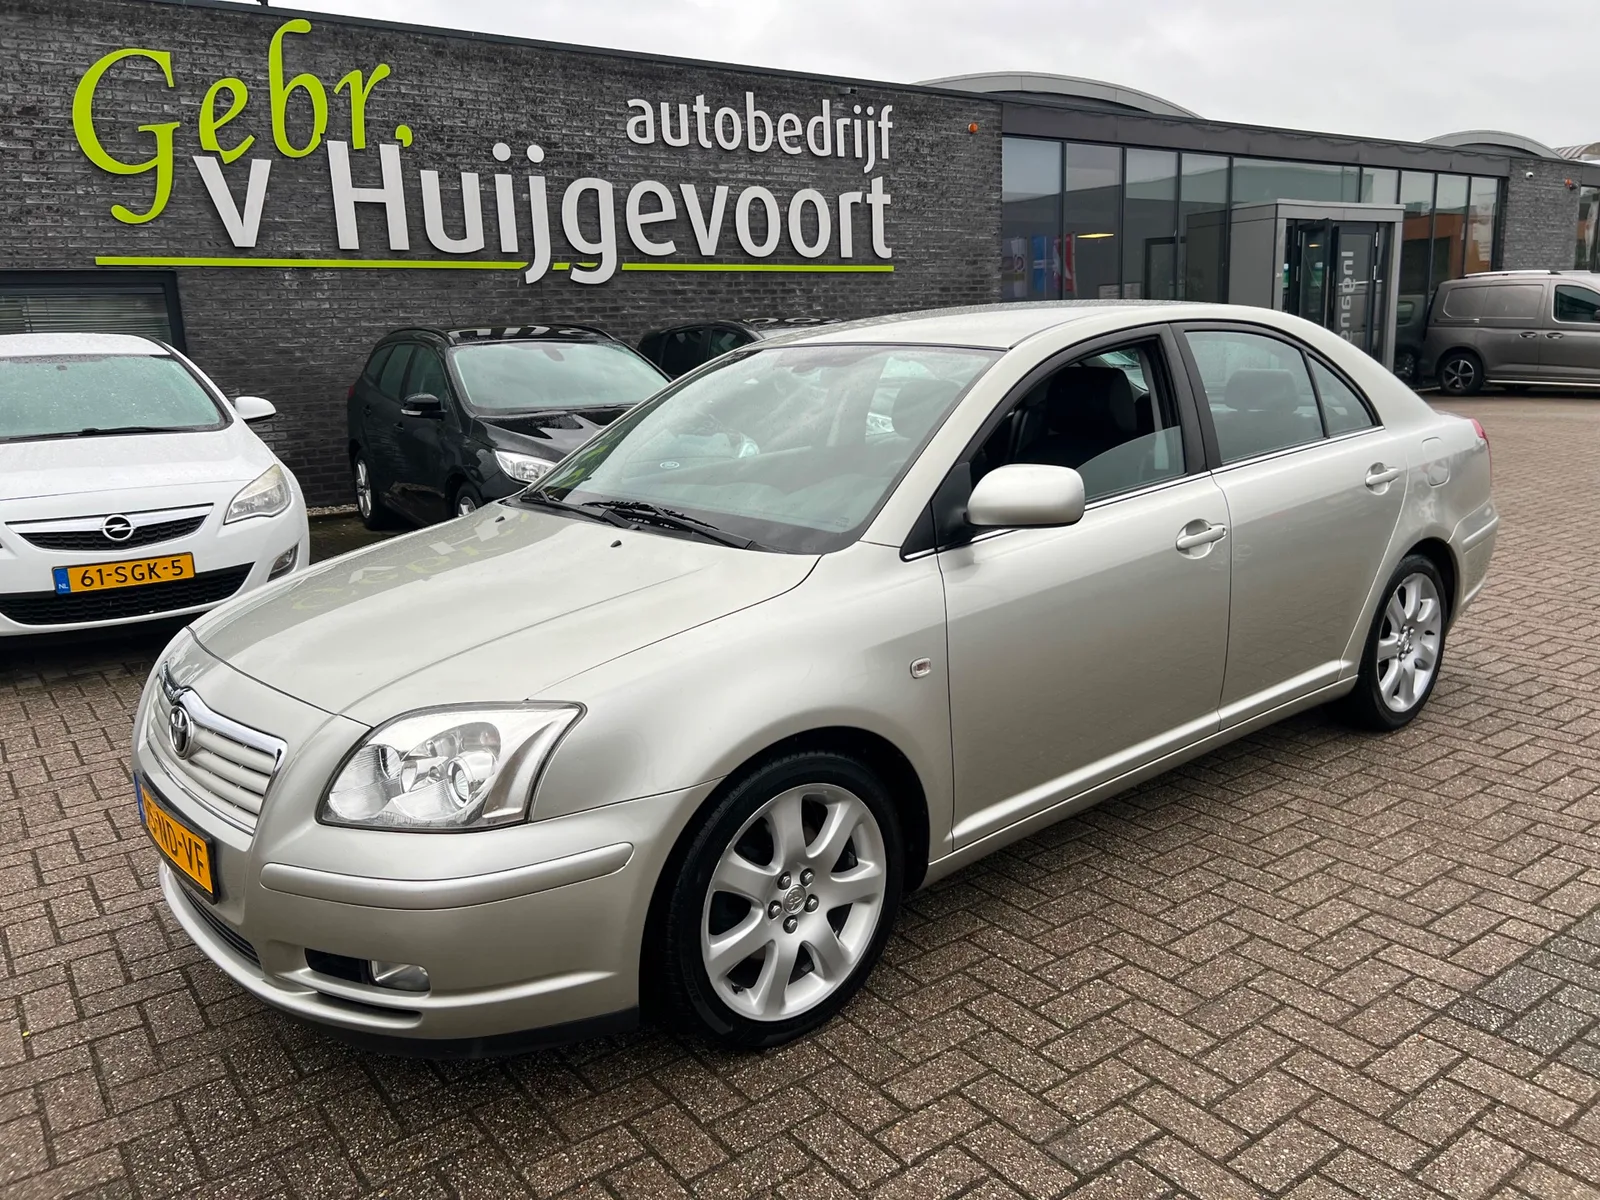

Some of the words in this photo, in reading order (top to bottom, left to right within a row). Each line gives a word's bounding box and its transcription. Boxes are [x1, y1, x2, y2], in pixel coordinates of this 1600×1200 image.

[72, 19, 413, 224] Gebr.
[626, 91, 893, 174] autobedrijf
[193, 155, 272, 248] v
[327, 140, 893, 285] Huijgevoort
[80, 559, 184, 587] 61-SGK-5
